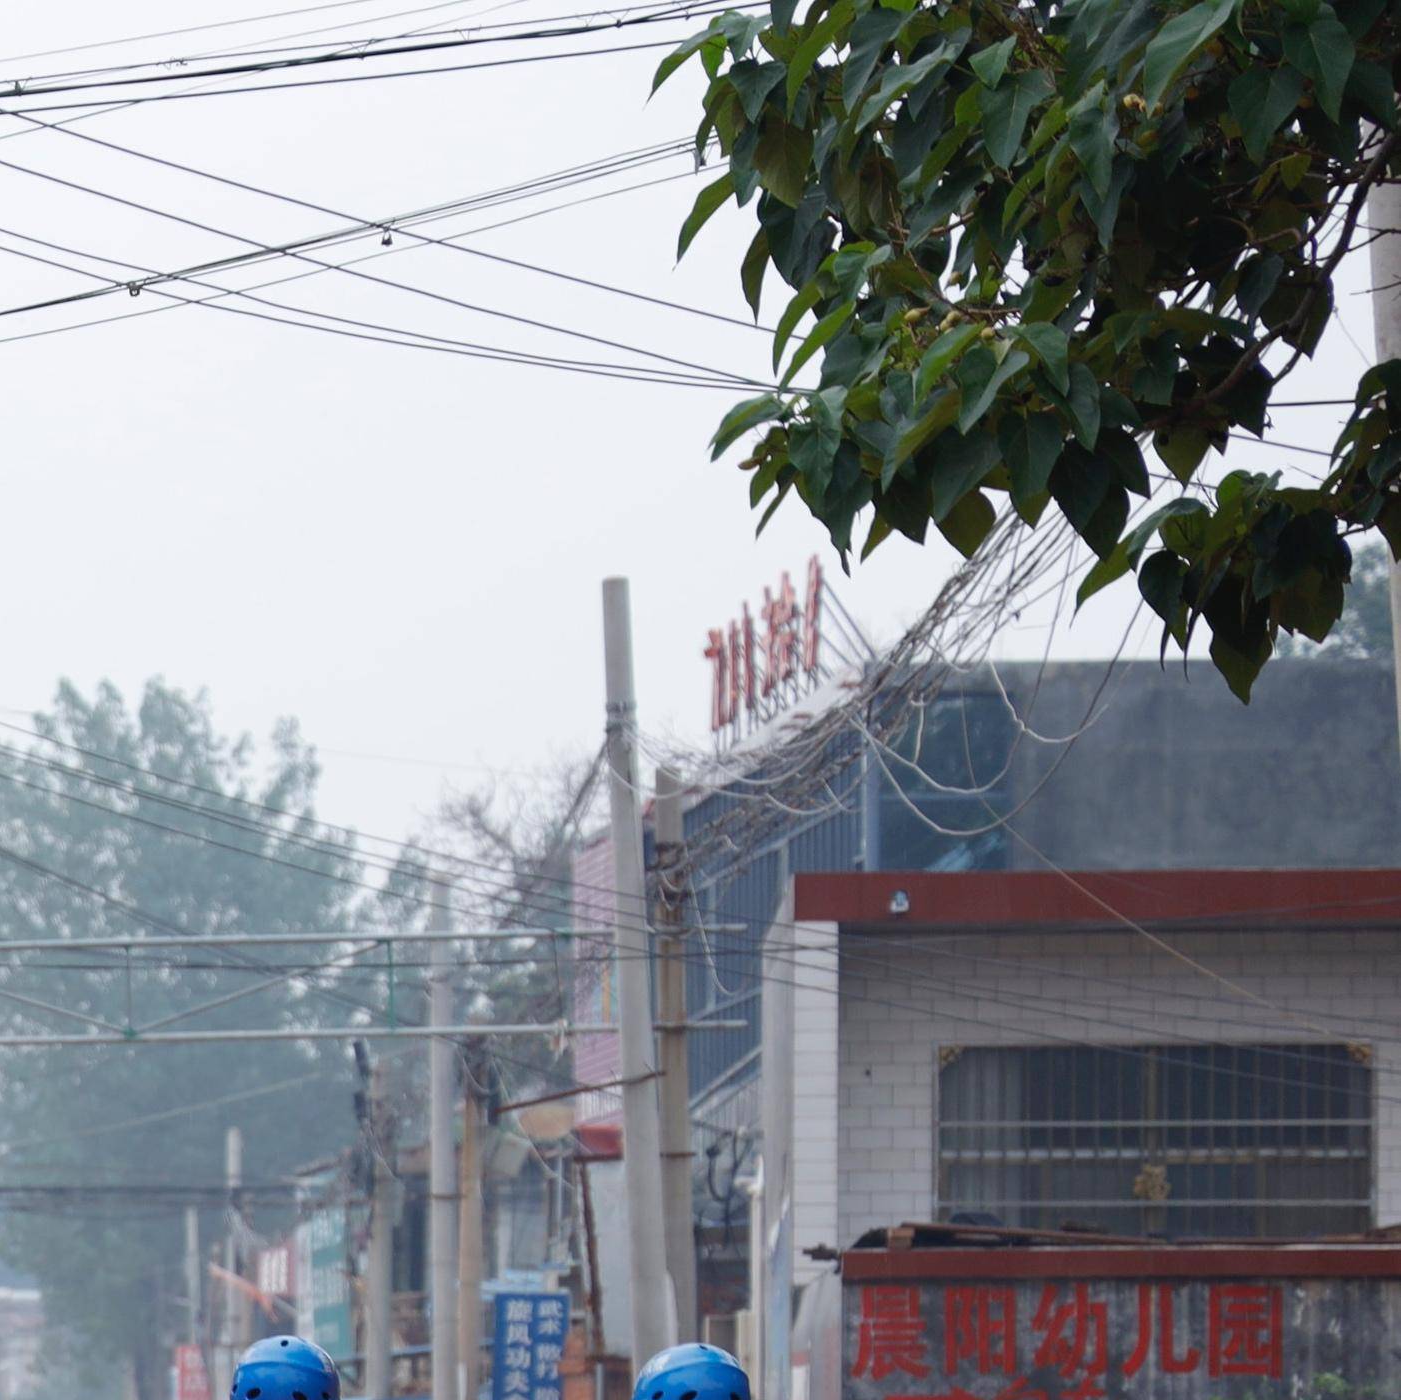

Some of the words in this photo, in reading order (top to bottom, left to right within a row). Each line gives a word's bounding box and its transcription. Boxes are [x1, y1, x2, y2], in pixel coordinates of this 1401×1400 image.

[851, 1284, 1284, 1381] 晨阳幼儿园
